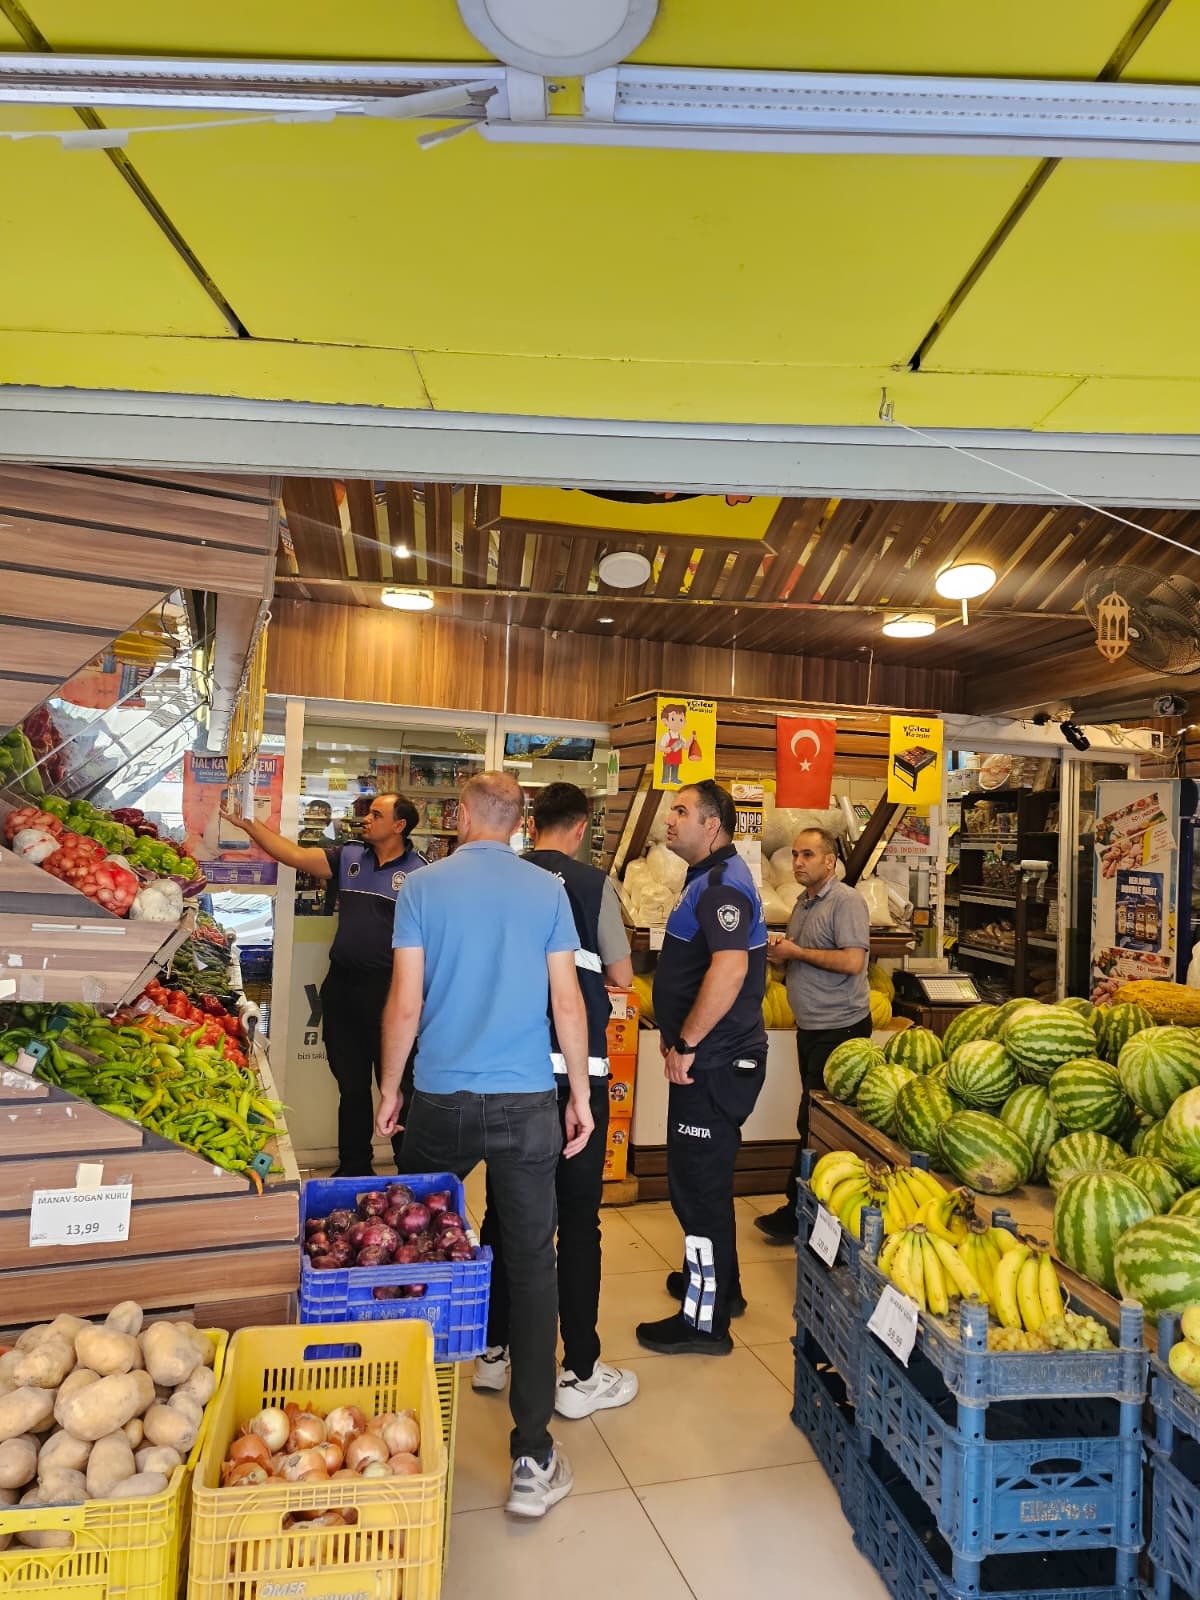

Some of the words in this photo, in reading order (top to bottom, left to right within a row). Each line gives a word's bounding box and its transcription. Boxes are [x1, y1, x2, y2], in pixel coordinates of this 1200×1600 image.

[192, 757, 210, 769] HAL
[678, 1123, 711, 1139] ZABITA
[38, 1195, 72, 1205] MANAV
[105, 1192, 128, 1200] KURU
[66, 1222, 99, 1235] 13,99
